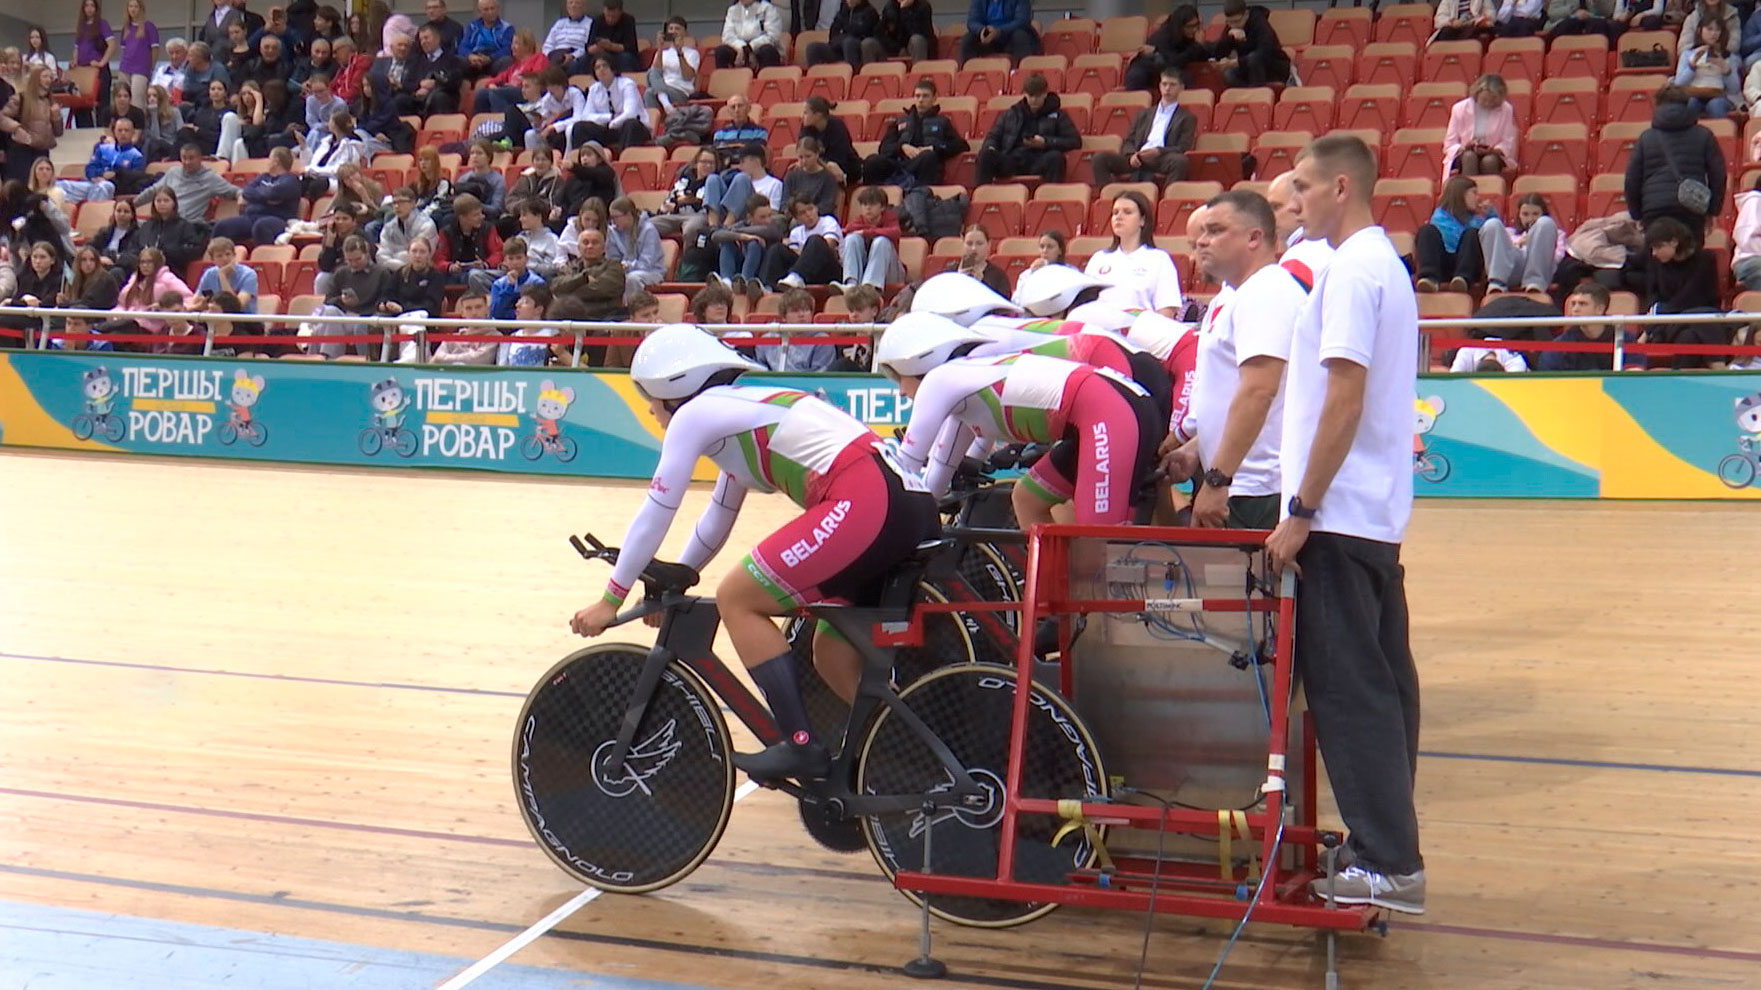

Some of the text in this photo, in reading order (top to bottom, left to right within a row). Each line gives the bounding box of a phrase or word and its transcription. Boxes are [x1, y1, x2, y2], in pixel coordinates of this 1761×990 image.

[122, 367, 224, 400] ПЕРШЫ
[414, 378, 528, 413] ПЕРШЫ
[846, 388, 914, 423] ПЕР
[128, 411, 213, 444] РОВАР
[422, 424, 516, 460] РОВАР
[1092, 422, 1110, 514] BELARUS
[780, 499, 852, 568] BELARUS
[521, 715, 634, 881] CAMPAGNOLO
